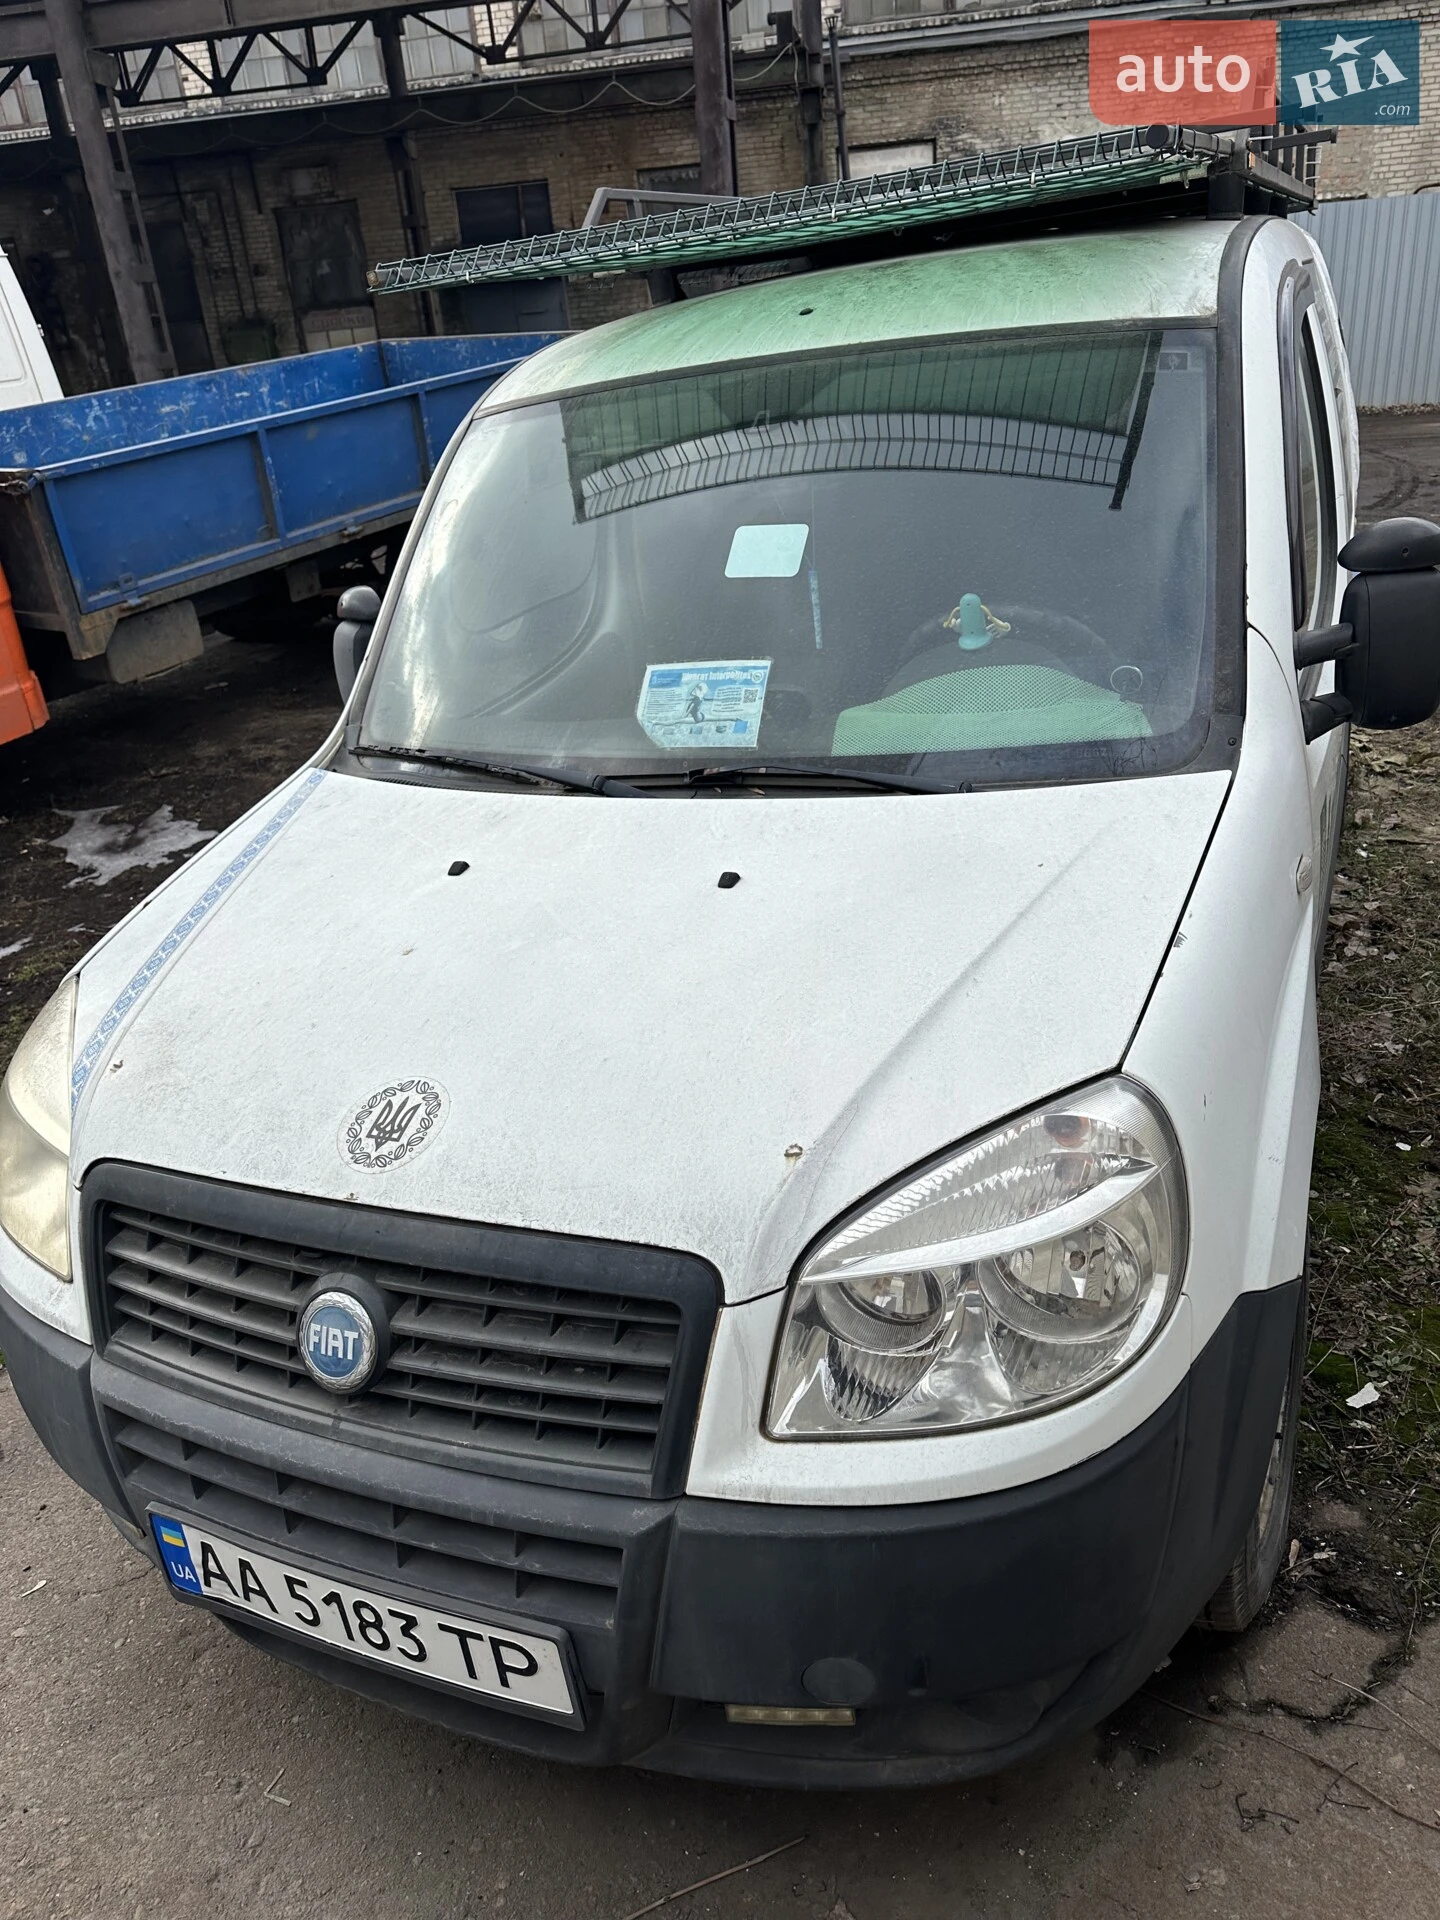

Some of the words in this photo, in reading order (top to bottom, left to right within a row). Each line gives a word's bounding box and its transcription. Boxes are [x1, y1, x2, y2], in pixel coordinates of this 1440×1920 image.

[308, 1322, 359, 1361] FIAT
[171, 1561, 197, 1584] UA
[200, 1540, 279, 1614] AA
[283, 1573, 428, 1663] 5183
[437, 1621, 540, 1689] TP
